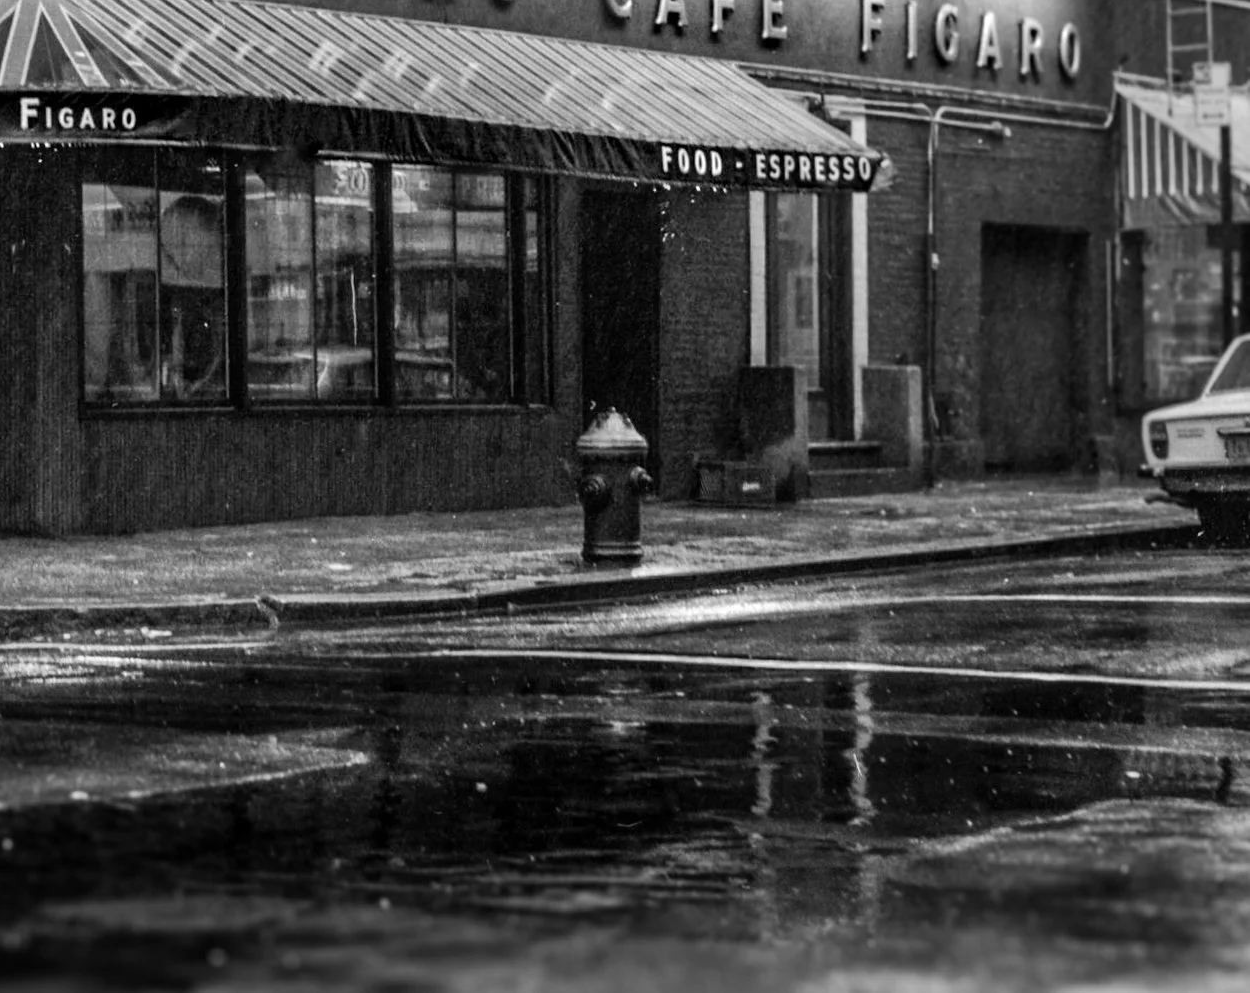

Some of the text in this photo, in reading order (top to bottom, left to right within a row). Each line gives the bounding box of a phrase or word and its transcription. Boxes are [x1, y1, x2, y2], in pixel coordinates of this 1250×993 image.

[19, 97, 137, 130] FIGARO
[660, 145, 872, 183] FOOD ESPRESSO
